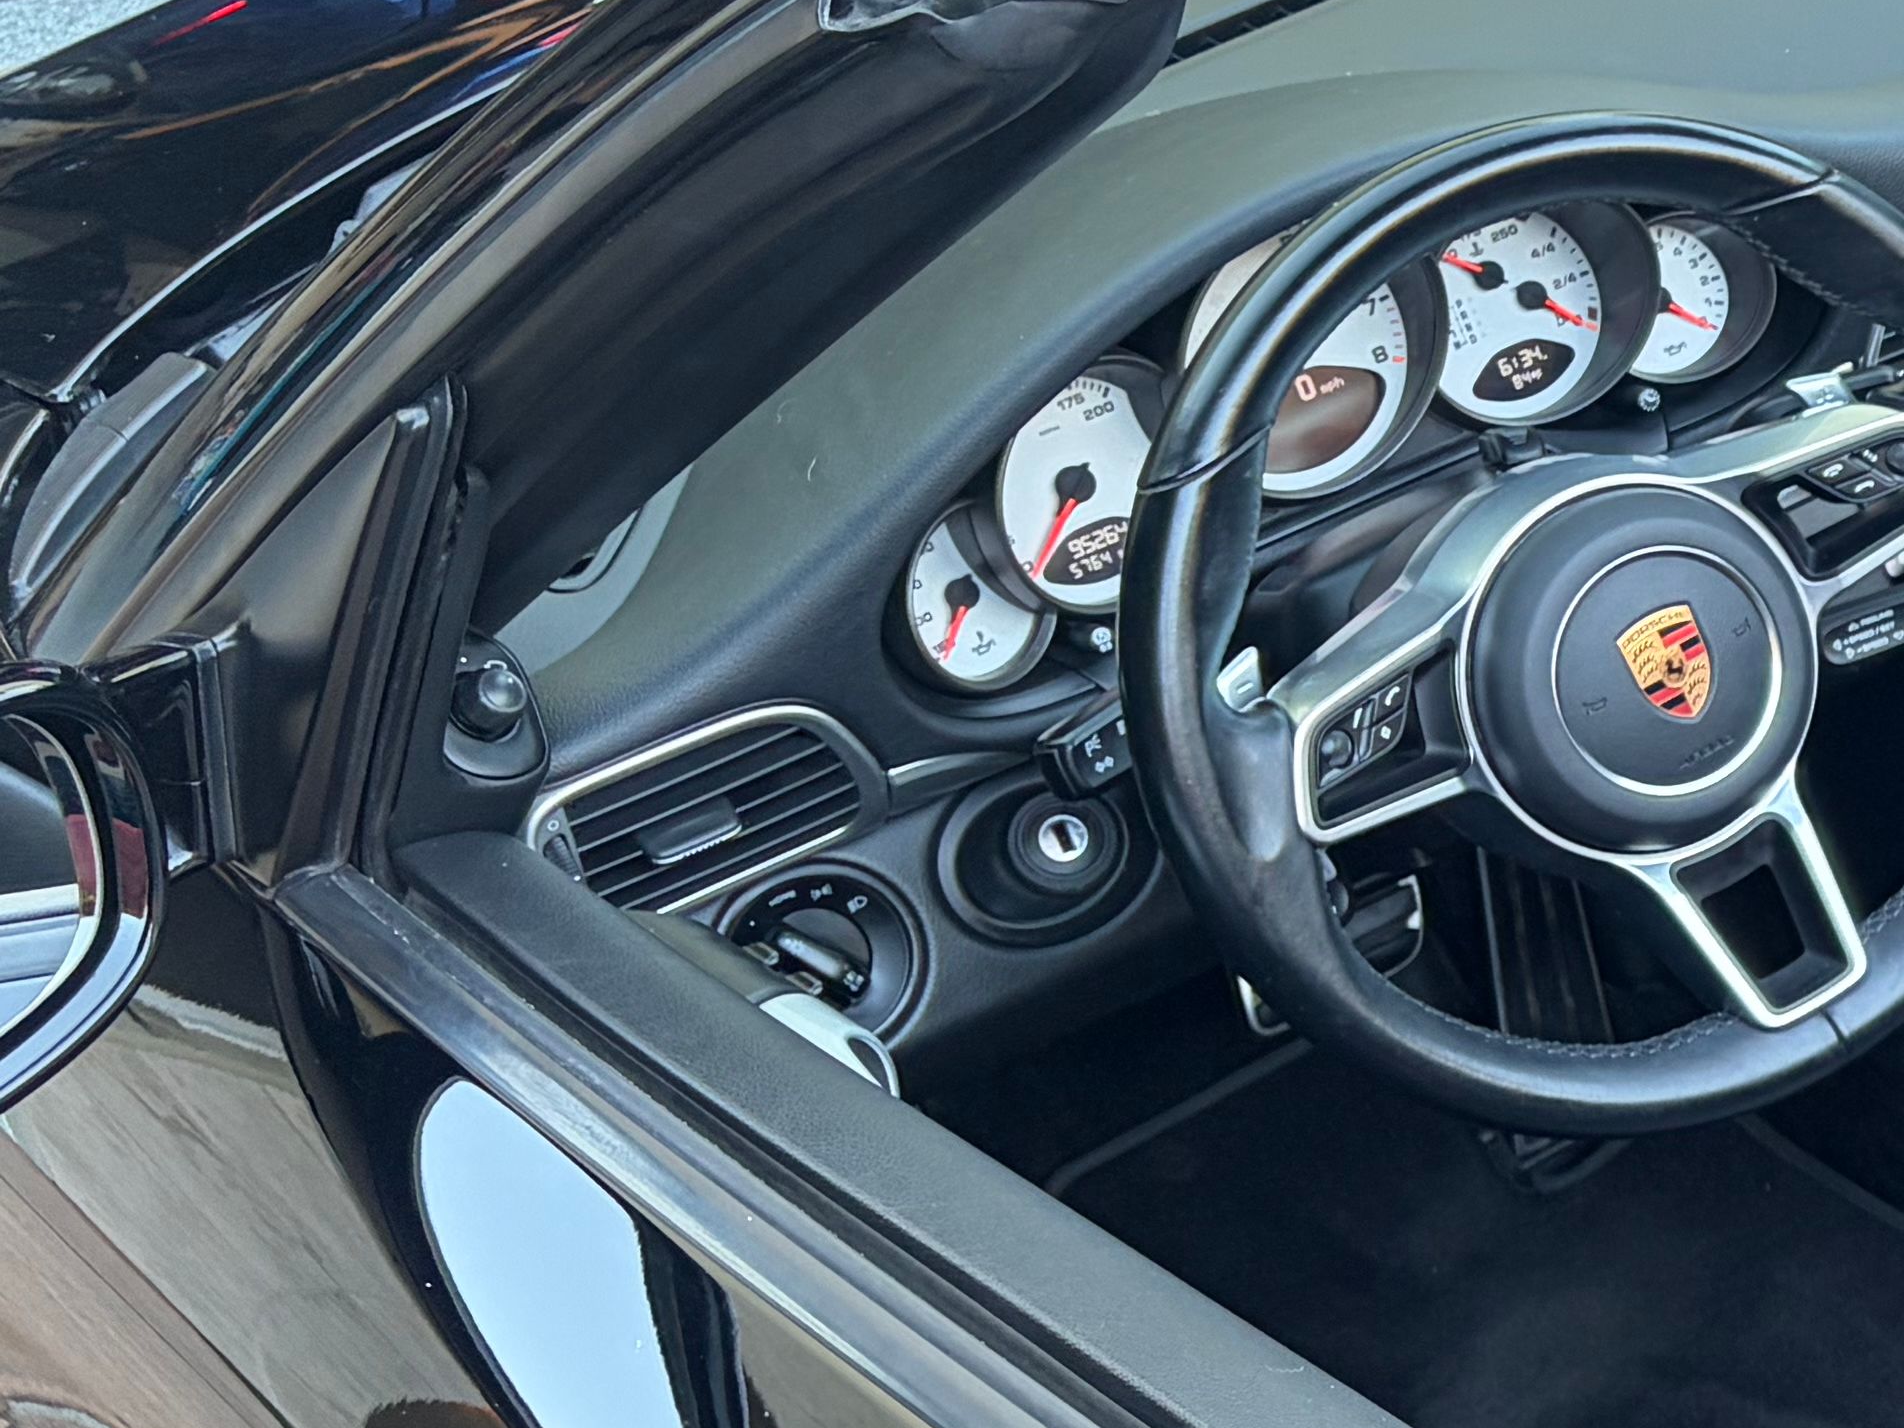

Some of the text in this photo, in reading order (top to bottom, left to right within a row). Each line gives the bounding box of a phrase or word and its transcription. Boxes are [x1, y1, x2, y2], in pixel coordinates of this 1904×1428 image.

[1490, 224, 1518, 243] 250
[1531, 244, 1556, 259] 4/4
[1688, 258, 1699, 270] 3
[1552, 273, 1577, 290] 2/4
[1699, 275, 1710, 287] 2
[1362, 298, 1376, 317] 7
[1372, 345, 1389, 364] 8
[1294, 373, 1345, 402] 0 mph
[1057, 392, 1085, 411] 175
[1083, 401, 1115, 422] 200
[1068, 521, 1128, 560] 95264
